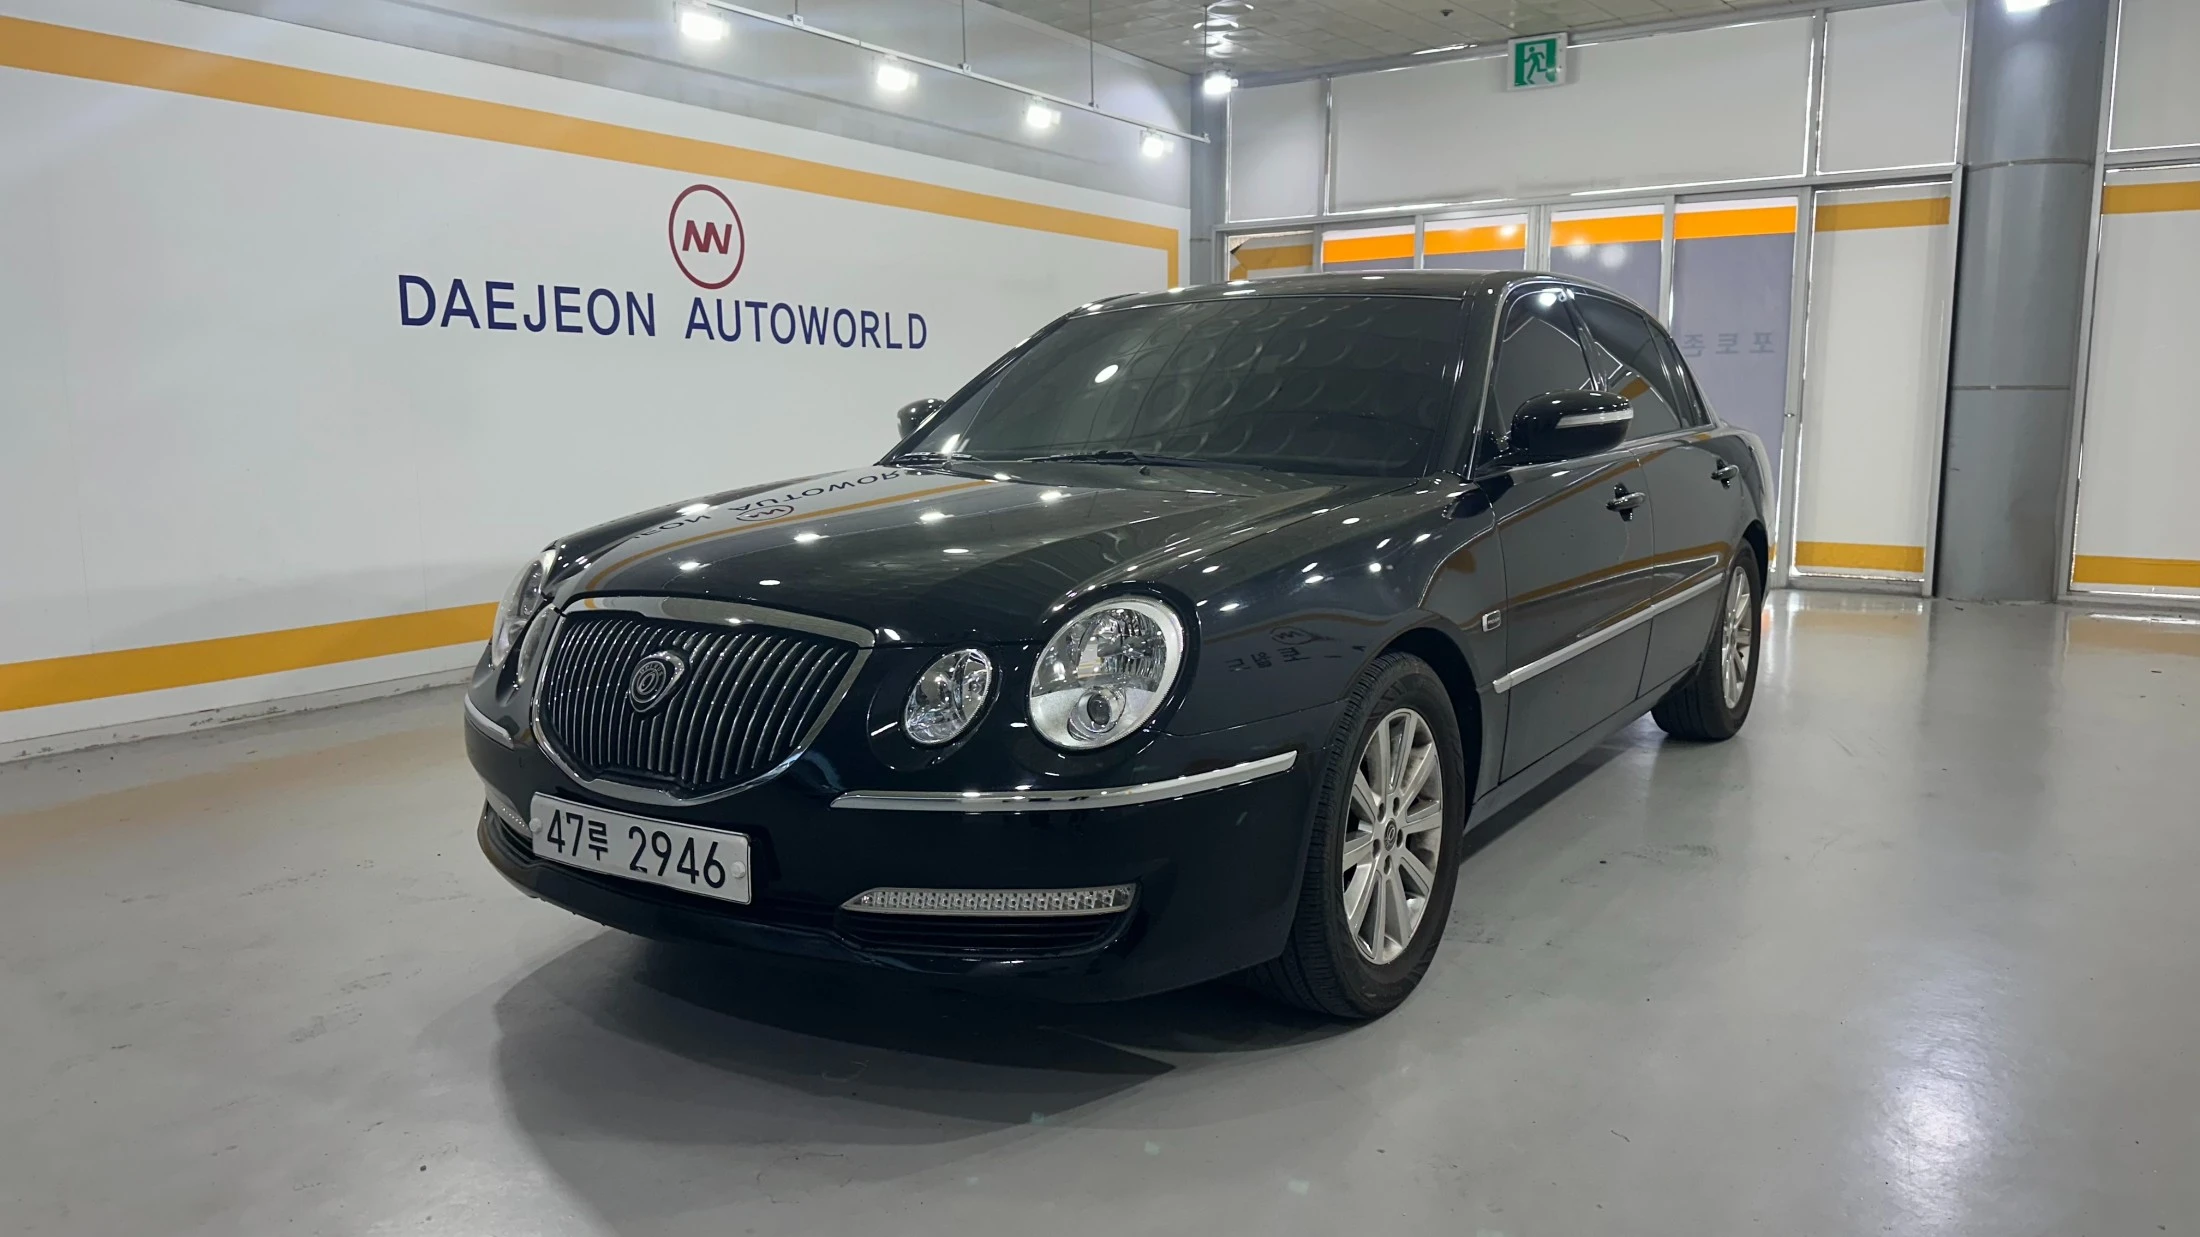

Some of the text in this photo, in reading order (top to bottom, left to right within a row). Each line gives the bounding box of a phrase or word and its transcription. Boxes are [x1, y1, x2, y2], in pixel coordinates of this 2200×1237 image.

[398, 274, 928, 350] DAEJEON AUTOWORLD
[547, 809, 726, 889] 47루 2946
